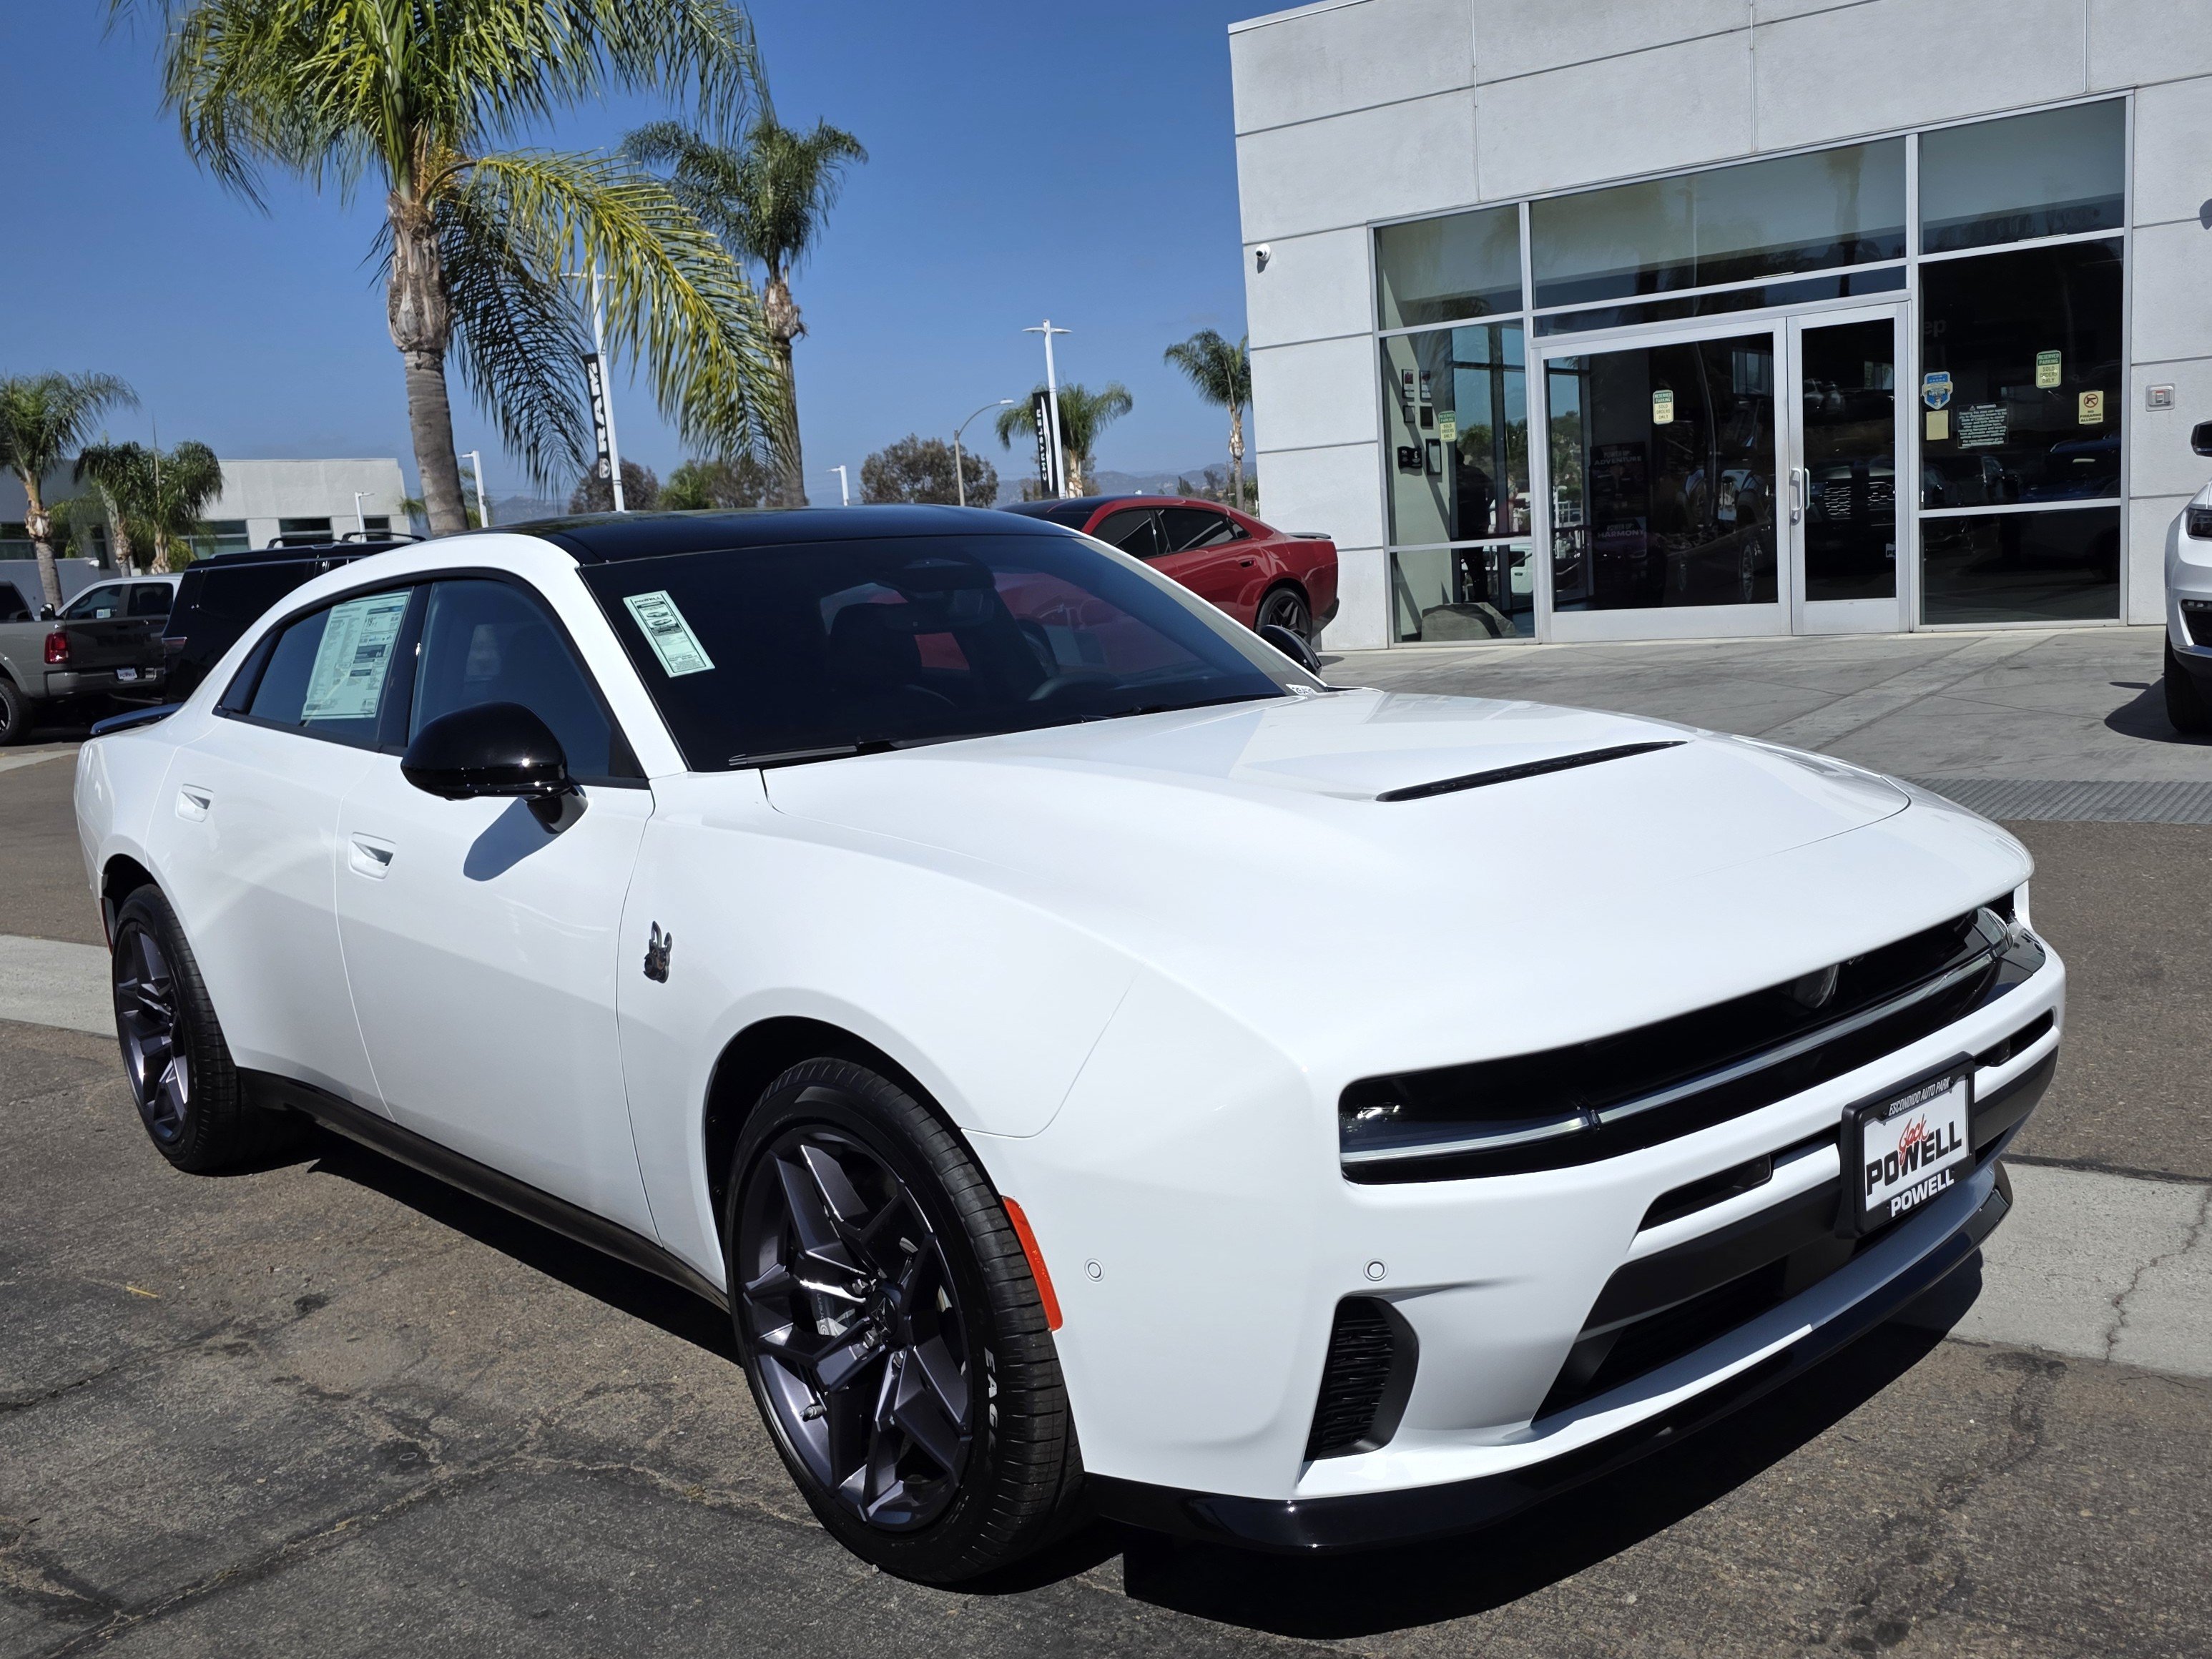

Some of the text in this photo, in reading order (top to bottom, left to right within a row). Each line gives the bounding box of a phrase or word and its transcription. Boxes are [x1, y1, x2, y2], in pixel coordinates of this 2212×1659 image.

[587, 362, 607, 453] RAM
[1036, 408, 1048, 481] CHRYSLER
[1594, 456, 1642, 466] ADVENTURE
[1597, 529, 1644, 538] HARMONY
[1889, 1076, 1951, 1116] ESCONDIDO AUTO PARK
[1866, 1121, 1962, 1196] POWELL
[1899, 1113, 1930, 1166] Jack
[1891, 1168, 1955, 1217] POWELL
